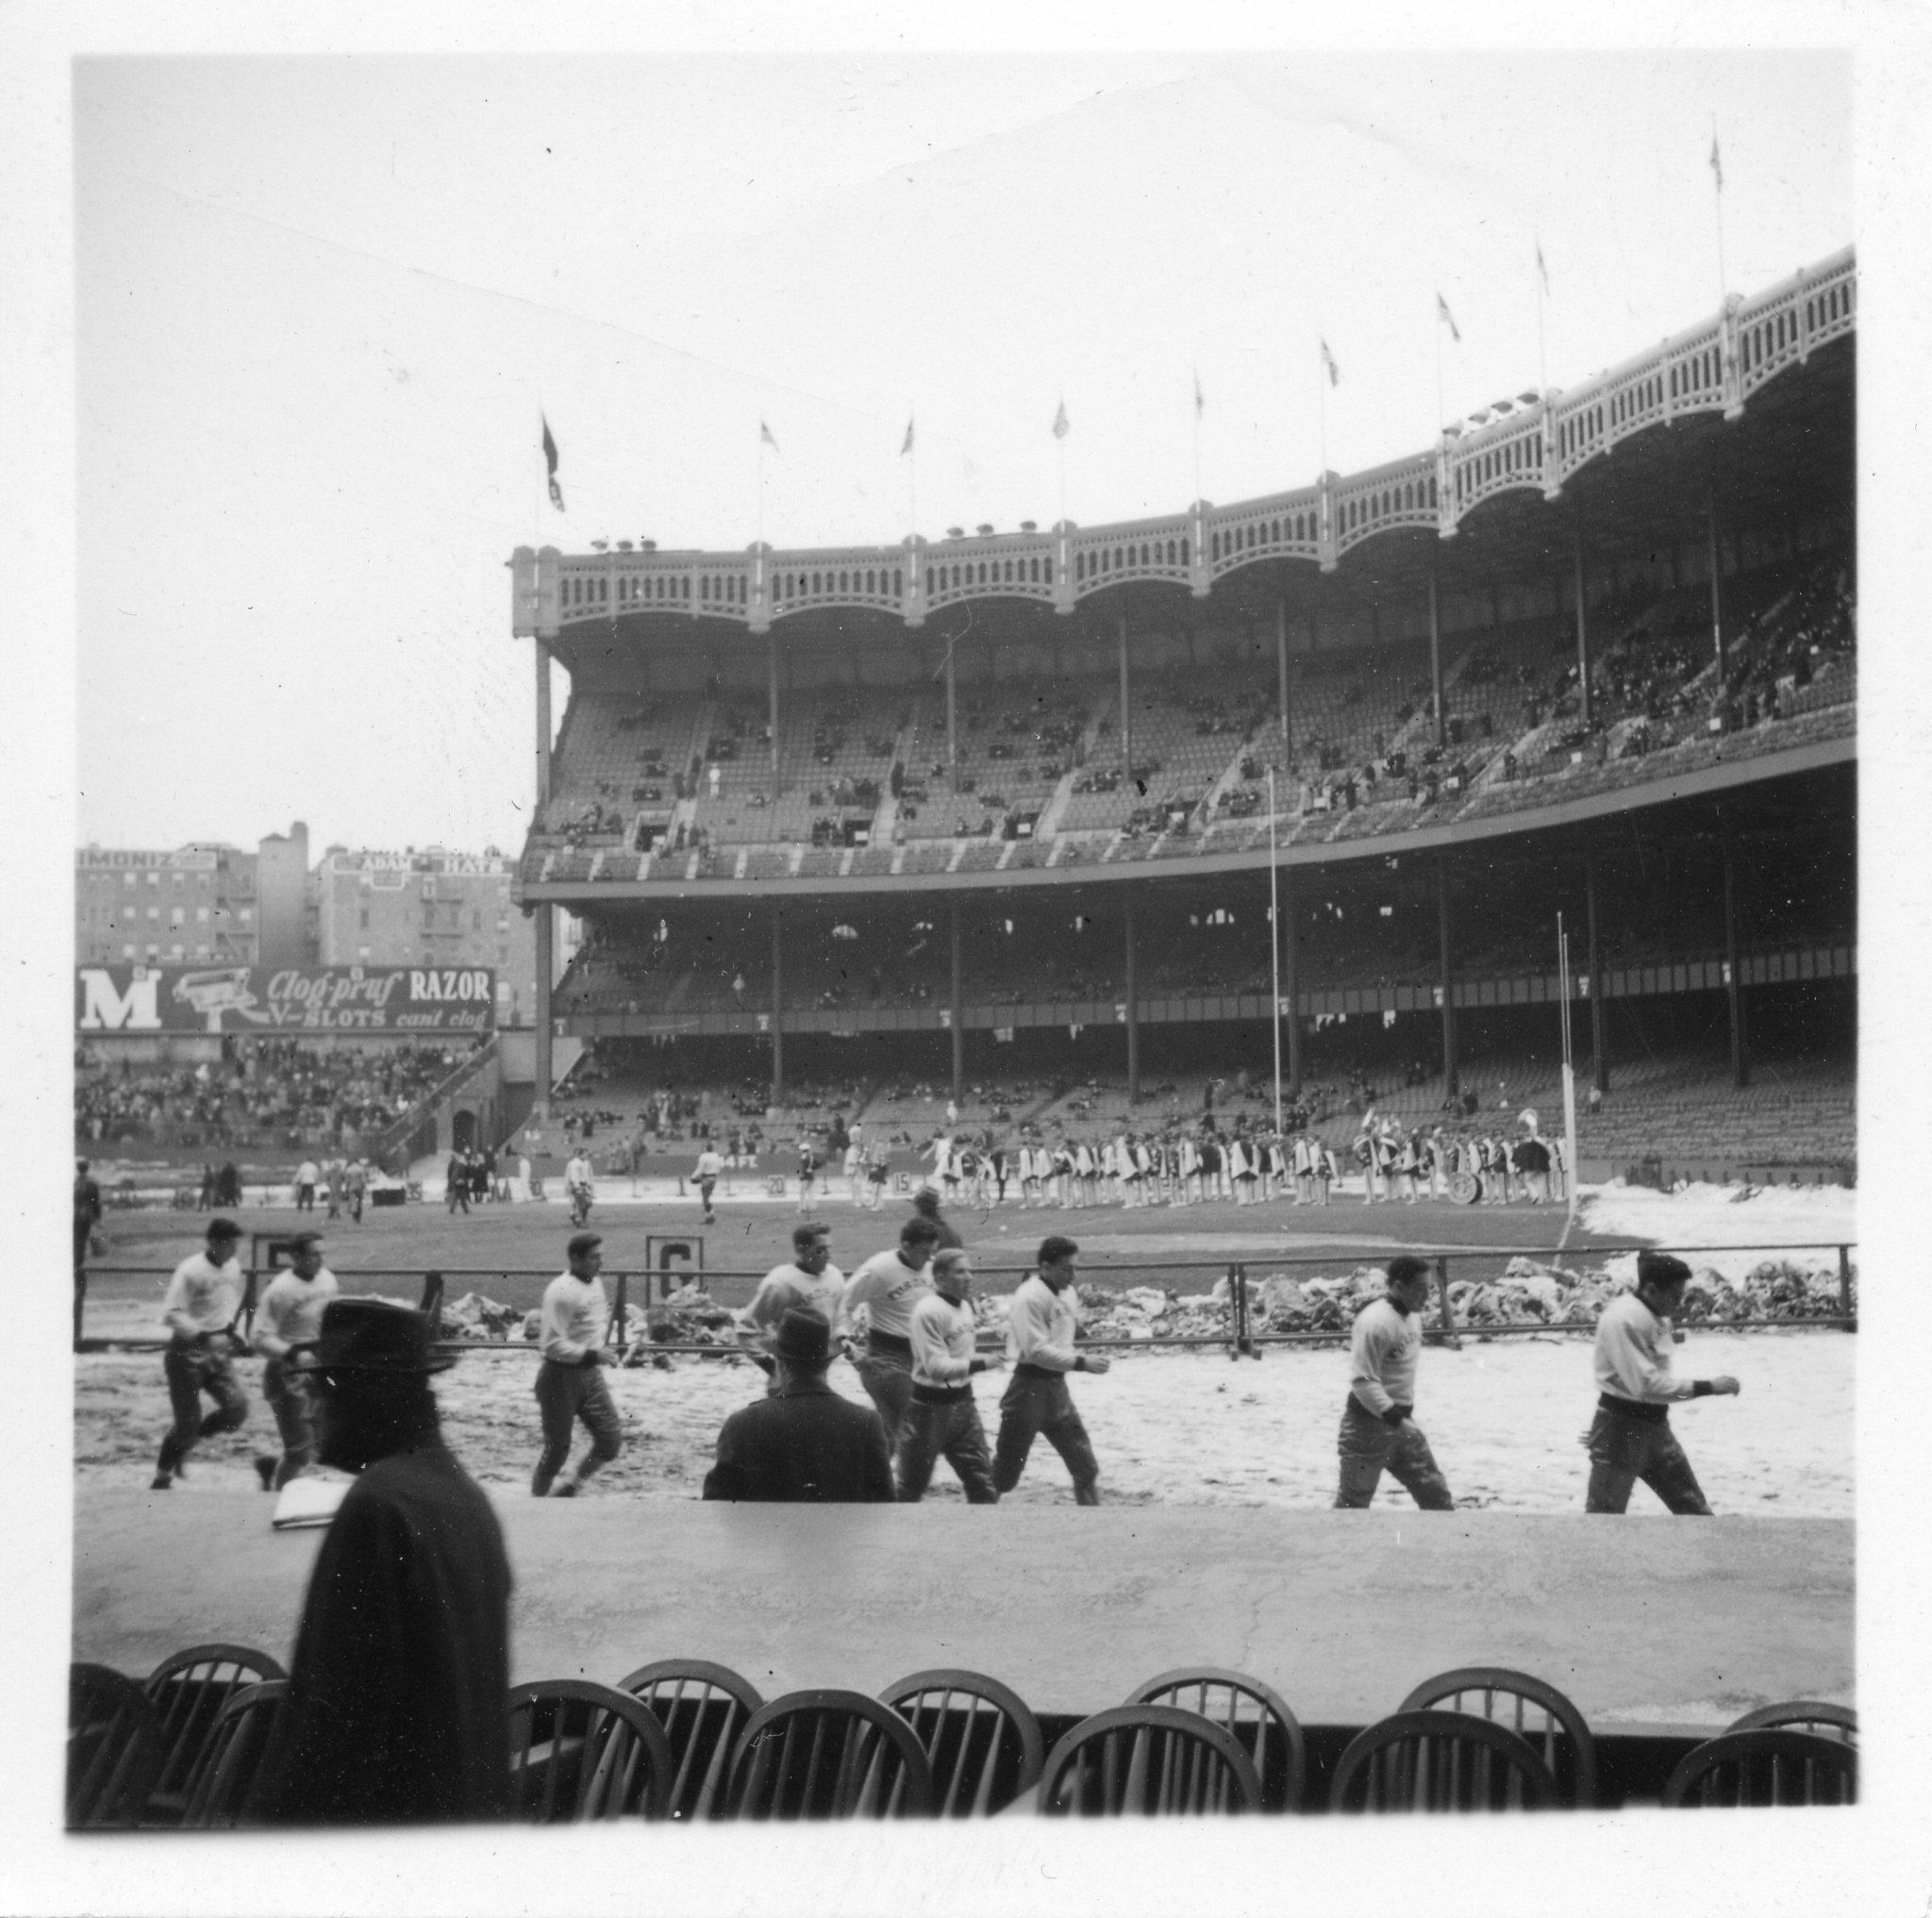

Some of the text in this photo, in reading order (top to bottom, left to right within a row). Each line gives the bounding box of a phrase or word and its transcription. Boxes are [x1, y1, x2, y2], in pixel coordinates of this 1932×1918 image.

[361, 858, 504, 874] ADAM HATS
[409, 970, 491, 1001] RAZOR
[79, 969, 162, 1029] M
[448, 1009, 488, 1031] clog
[769, 1177, 785, 1195] 20
[896, 1174, 909, 1192] 15
